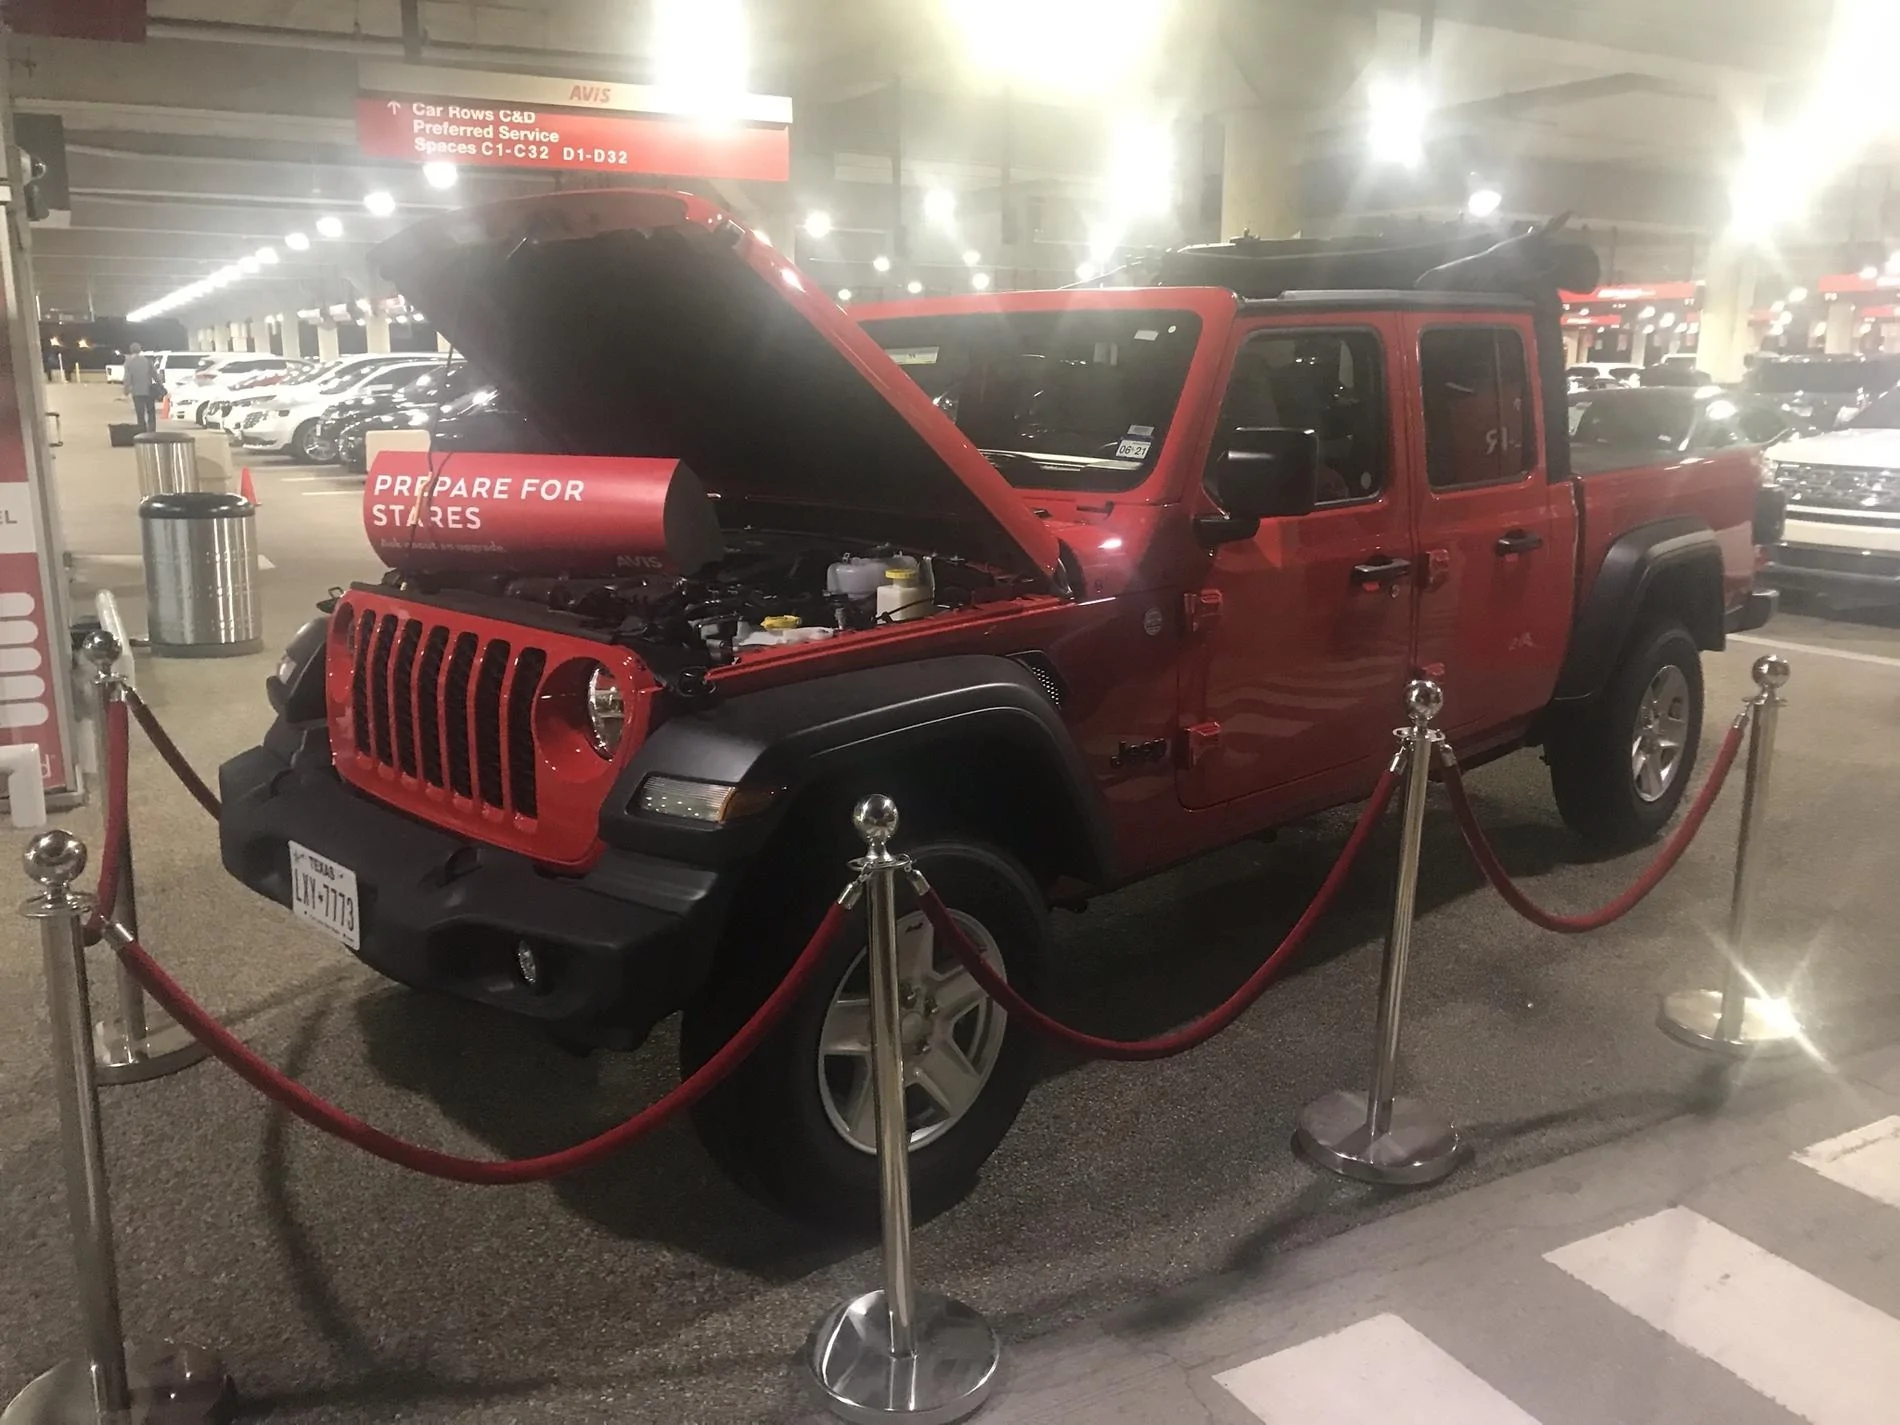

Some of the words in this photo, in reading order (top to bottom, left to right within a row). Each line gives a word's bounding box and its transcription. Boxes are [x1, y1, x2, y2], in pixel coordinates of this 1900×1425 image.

[412, 102, 444, 117] Car
[448, 105, 494, 121] Rows
[499, 110, 536, 124] C&D
[413, 119, 494, 139] Preferred
[498, 125, 559, 142] Service
[414, 136, 476, 154] Spaces
[481, 141, 549, 159] C1-C32
[562, 147, 628, 164] D1-D32
[373, 474, 513, 499] PREPARE
[520, 479, 586, 501] FOR
[372, 504, 482, 530] STARES
[616, 554, 664, 569] AVIS
